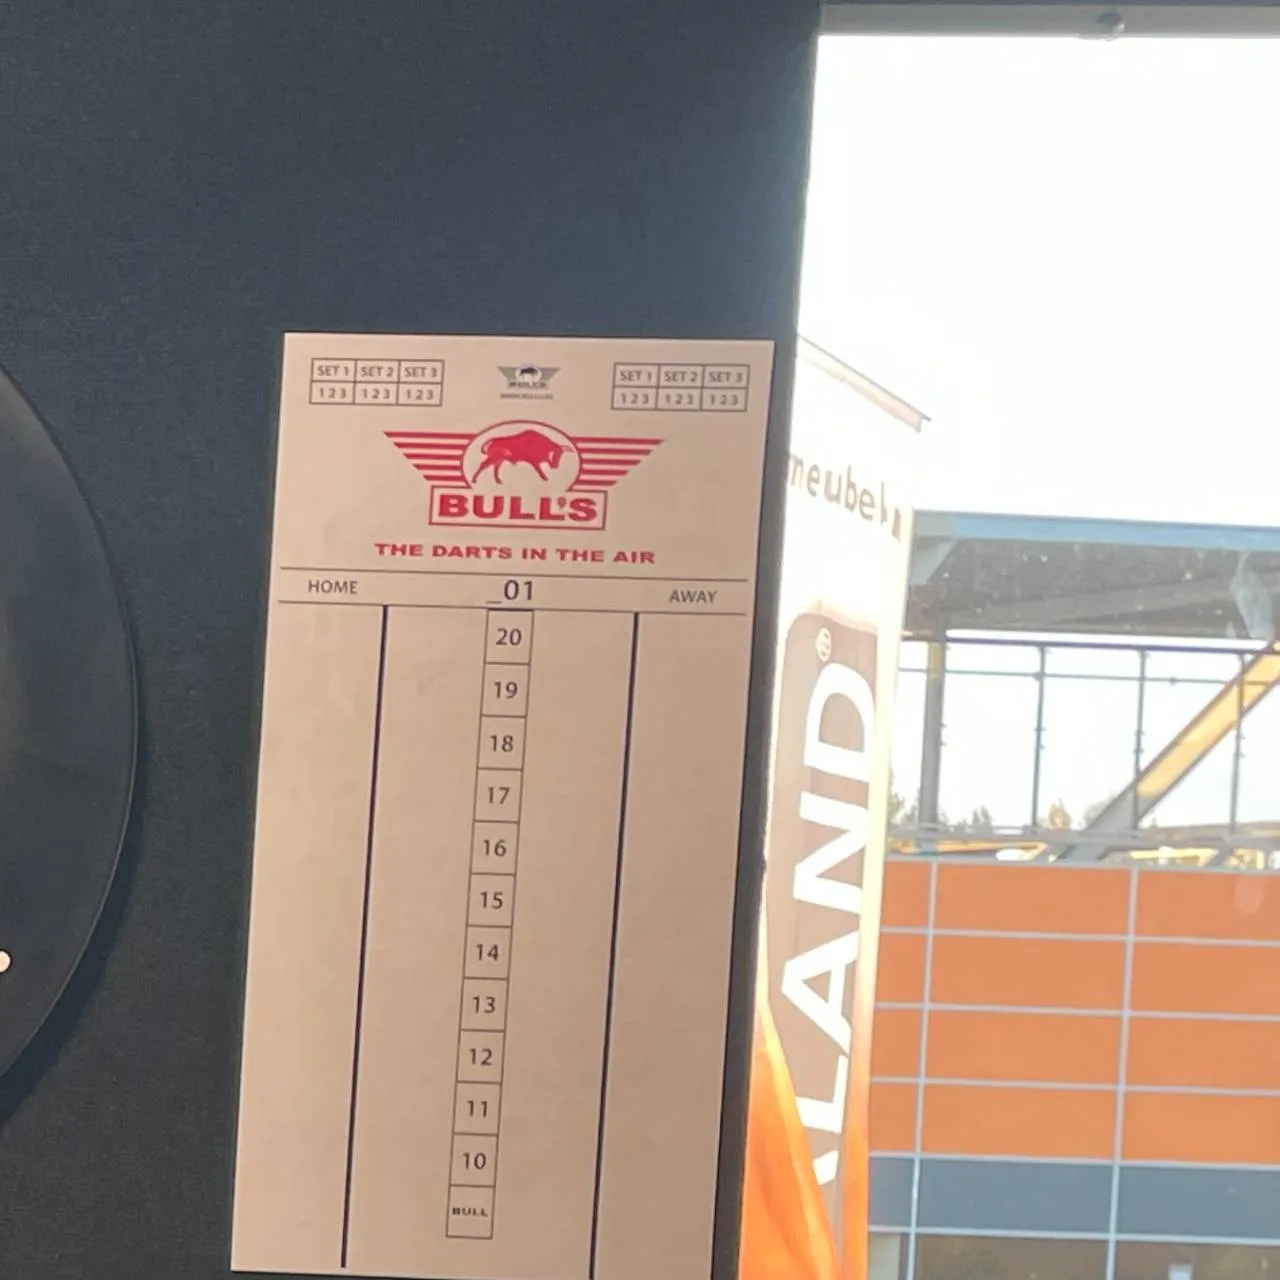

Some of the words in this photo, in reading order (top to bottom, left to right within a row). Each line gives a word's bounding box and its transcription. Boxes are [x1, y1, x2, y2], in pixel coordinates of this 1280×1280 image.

[317, 365, 340, 377] SET
[360, 366, 383, 378] SET
[404, 366, 427, 378] SET
[619, 372, 642, 382] SET
[664, 372, 687, 382] SET
[709, 373, 731, 383] SET
[437, 494, 598, 522] BULL'S
[374, 542, 424, 558] THE
[431, 544, 513, 560] DARTS
[521, 546, 547, 562] IN
[555, 547, 605, 563] THE
[612, 549, 657, 565] AIR
[308, 579, 358, 595] HOME
[668, 588, 718, 604] AWAY
[495, 627, 522, 646] 20
[493, 680, 518, 699] 19
[489, 734, 514, 753] 18
[487, 786, 511, 805] 17
[483, 838, 507, 857] 16
[480, 891, 504, 910] 15
[475, 943, 500, 962] 14
[472, 995, 497, 1014] 13
[469, 1047, 493, 1067] 12
[466, 1099, 489, 1118] 11
[462, 1151, 487, 1170] 10
[451, 1207, 489, 1217] BULL
